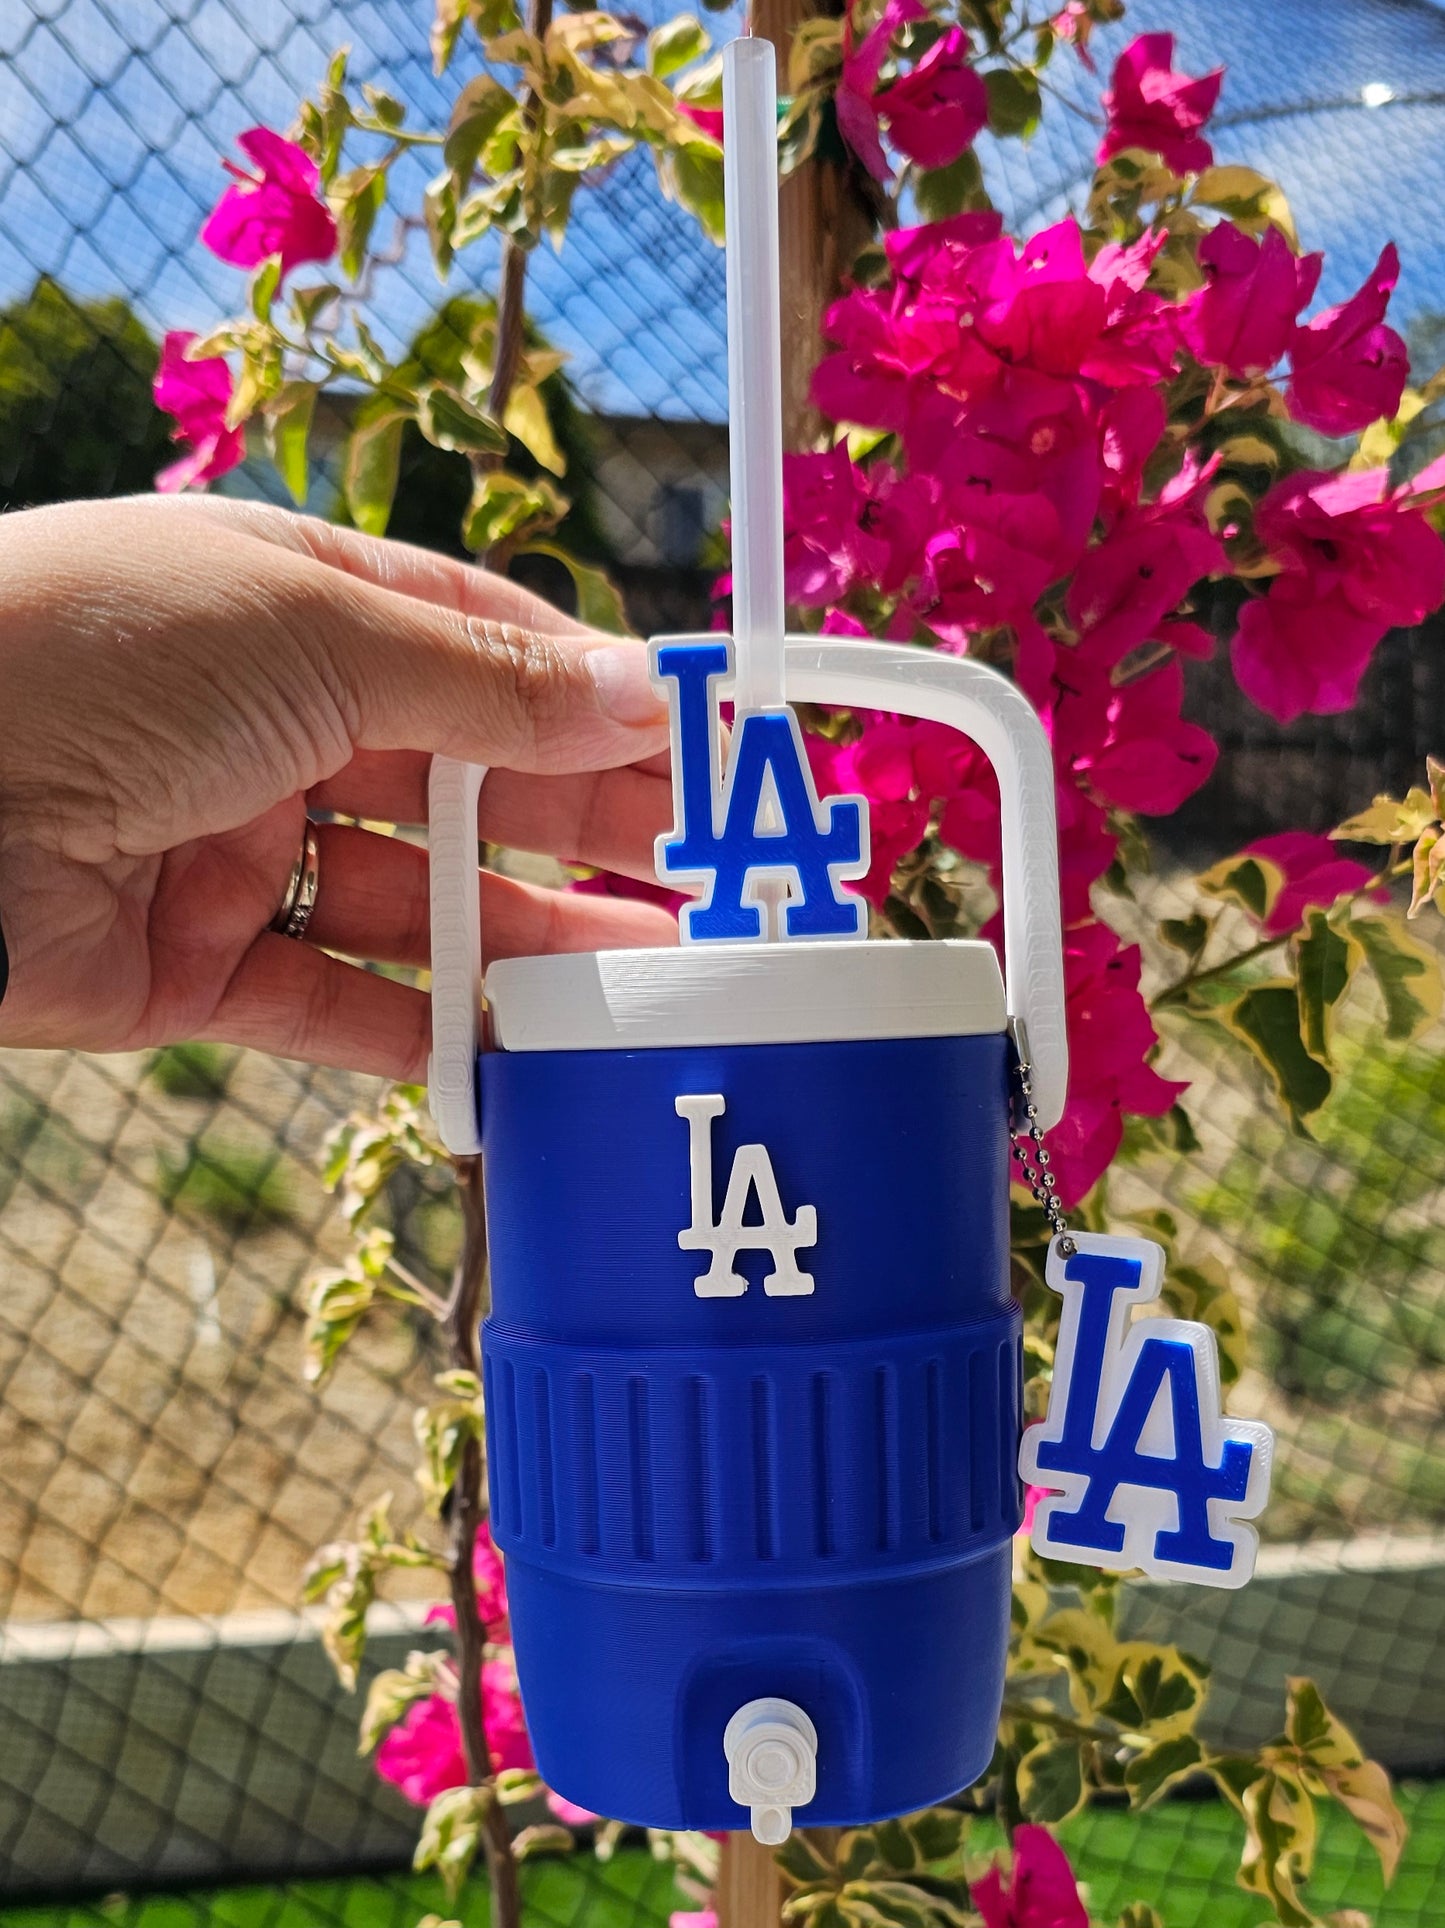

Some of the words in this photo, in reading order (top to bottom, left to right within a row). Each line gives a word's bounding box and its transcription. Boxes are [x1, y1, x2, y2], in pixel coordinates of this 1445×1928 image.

[657, 644, 861, 940] LA
[674, 1093, 818, 1298] LA
[1036, 1253, 1253, 1571] LA
